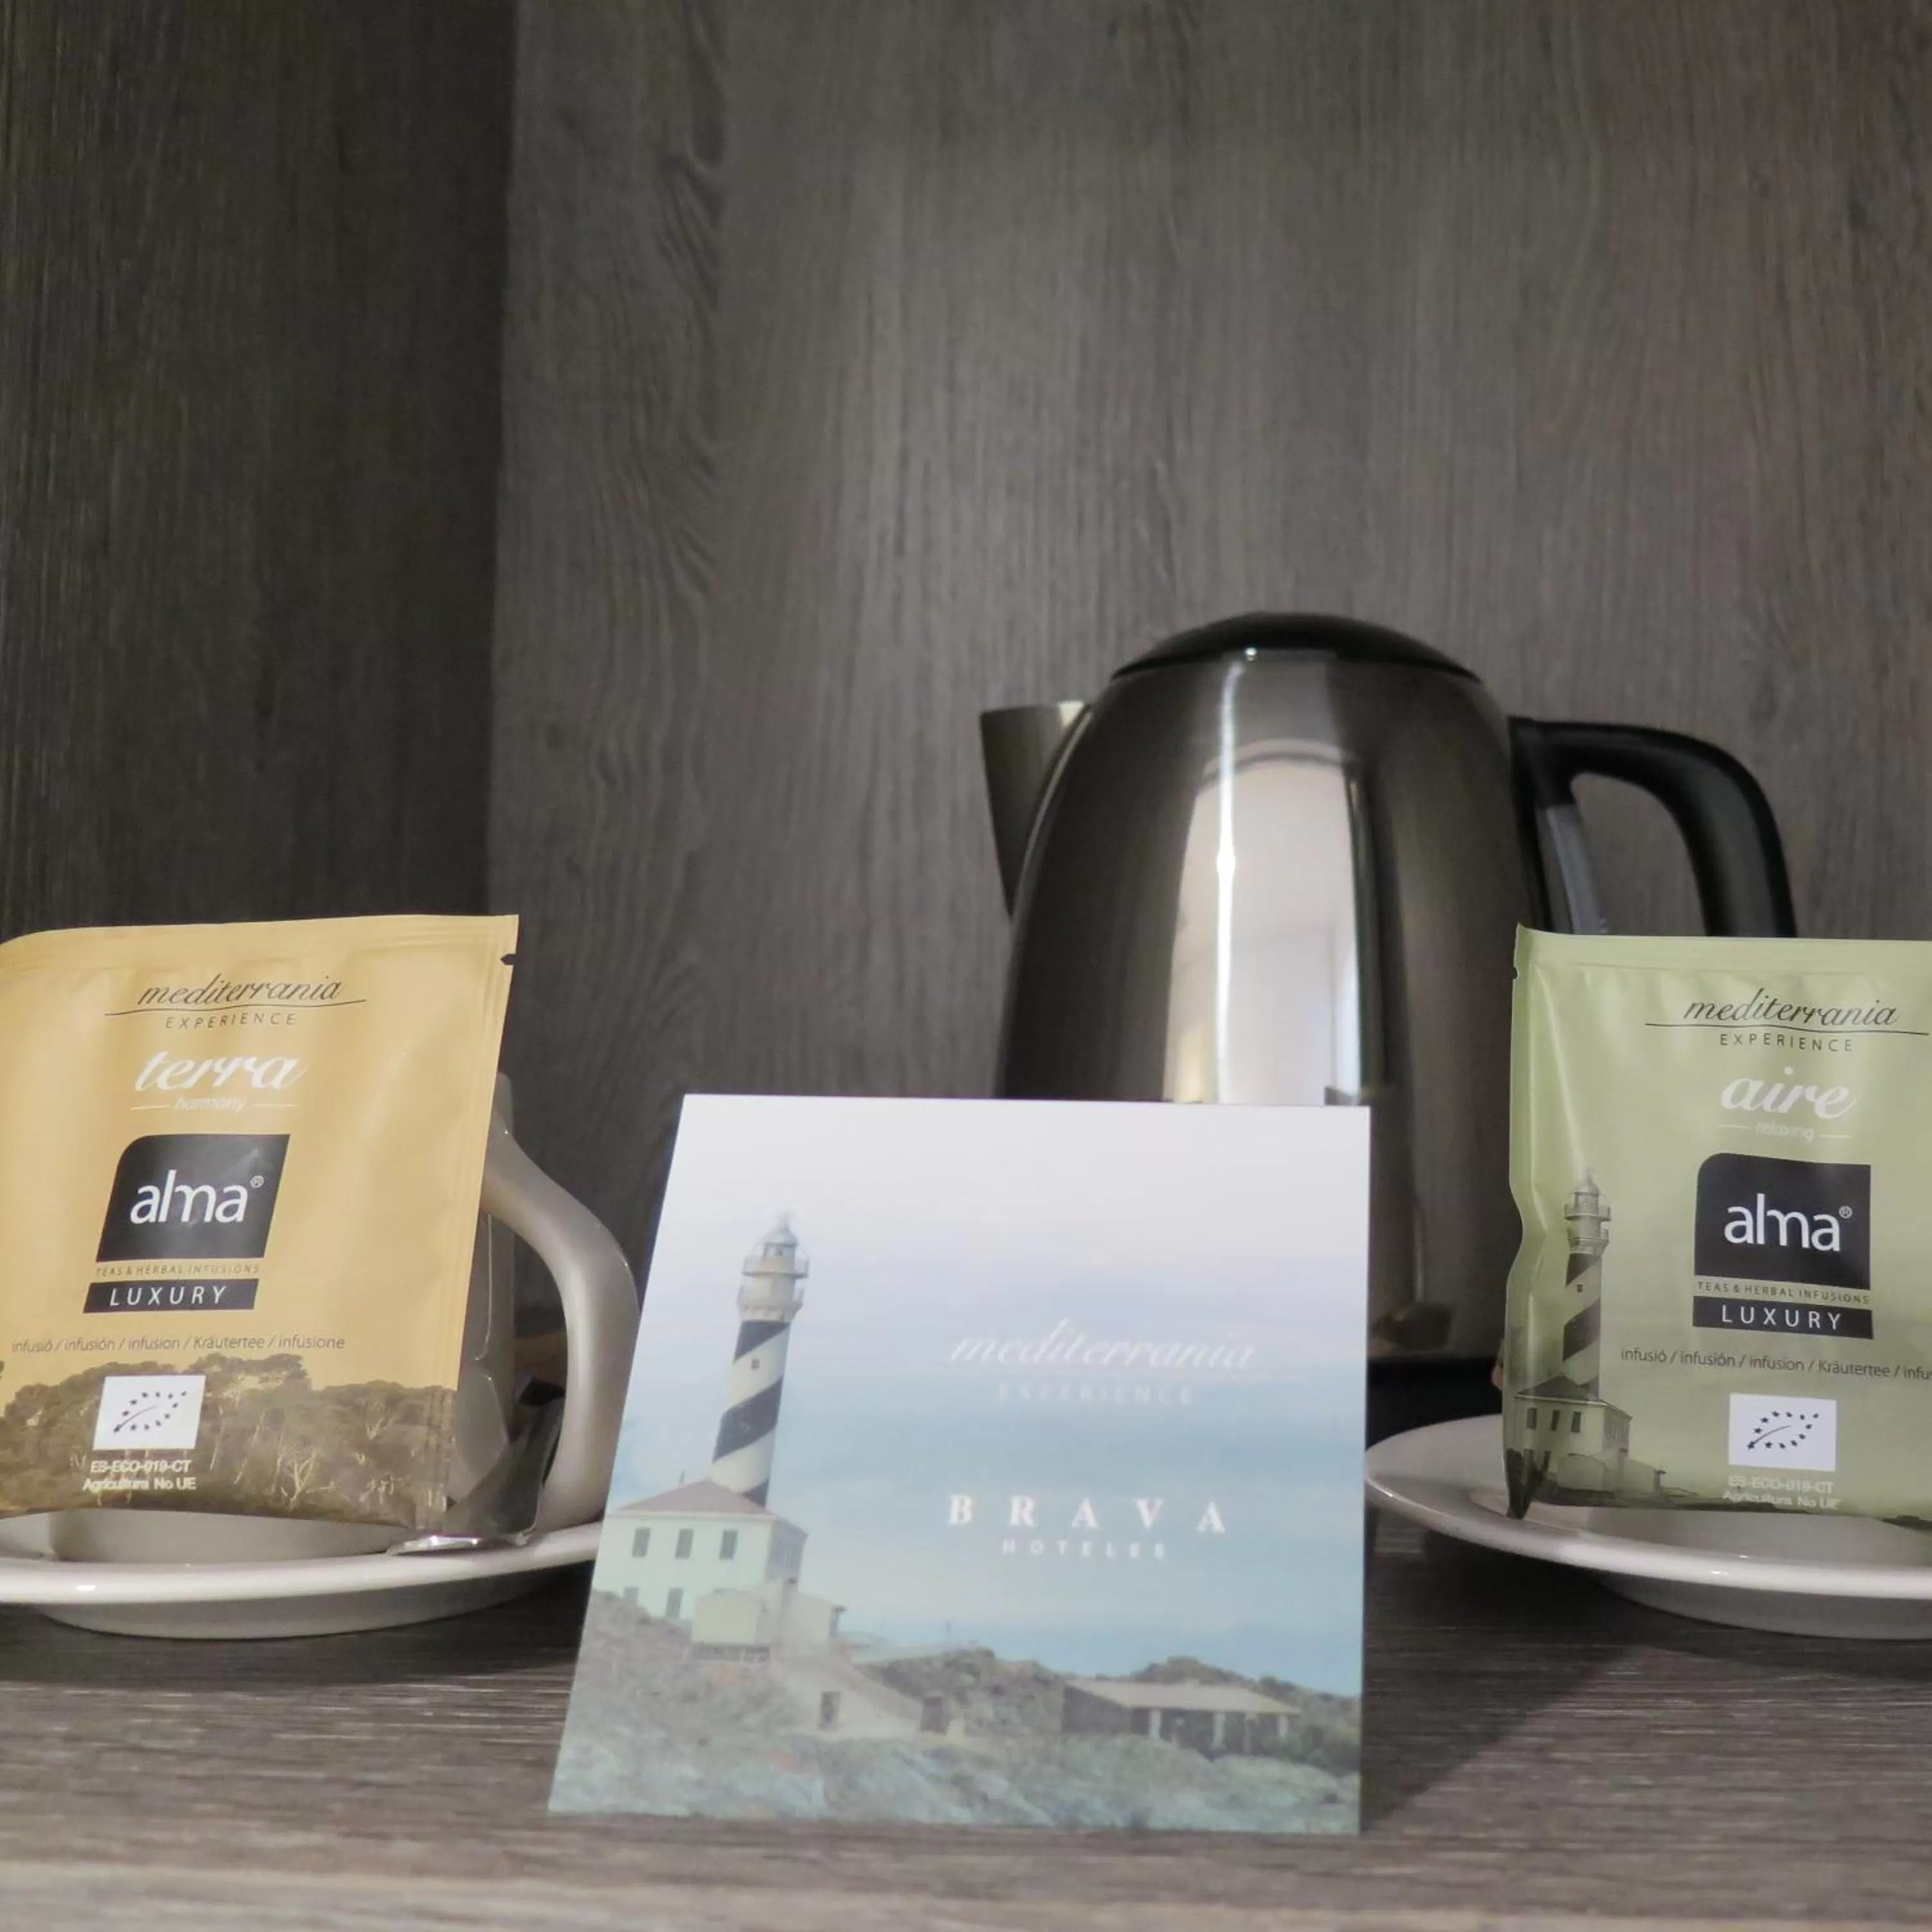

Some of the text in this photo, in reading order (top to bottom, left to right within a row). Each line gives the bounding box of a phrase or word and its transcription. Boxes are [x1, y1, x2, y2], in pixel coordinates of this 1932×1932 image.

[137, 973, 343, 1004] mediterrania
[166, 1012, 296, 1028] EXPERIENCE
[1683, 987, 1899, 1026] mediterrania
[1720, 1033, 1853, 1052] EXPERIENCE
[134, 1050, 310, 1092] terra
[1720, 1066, 1861, 1119] aire
[109, 1285, 227, 1307] LUXURY
[1721, 1303, 1841, 1331] LUXURY
[951, 1318, 1256, 1368] mediterrania
[153, 1477, 174, 1490] No
[176, 1477, 196, 1490] UE
[947, 1495, 1226, 1534] BRAVA
